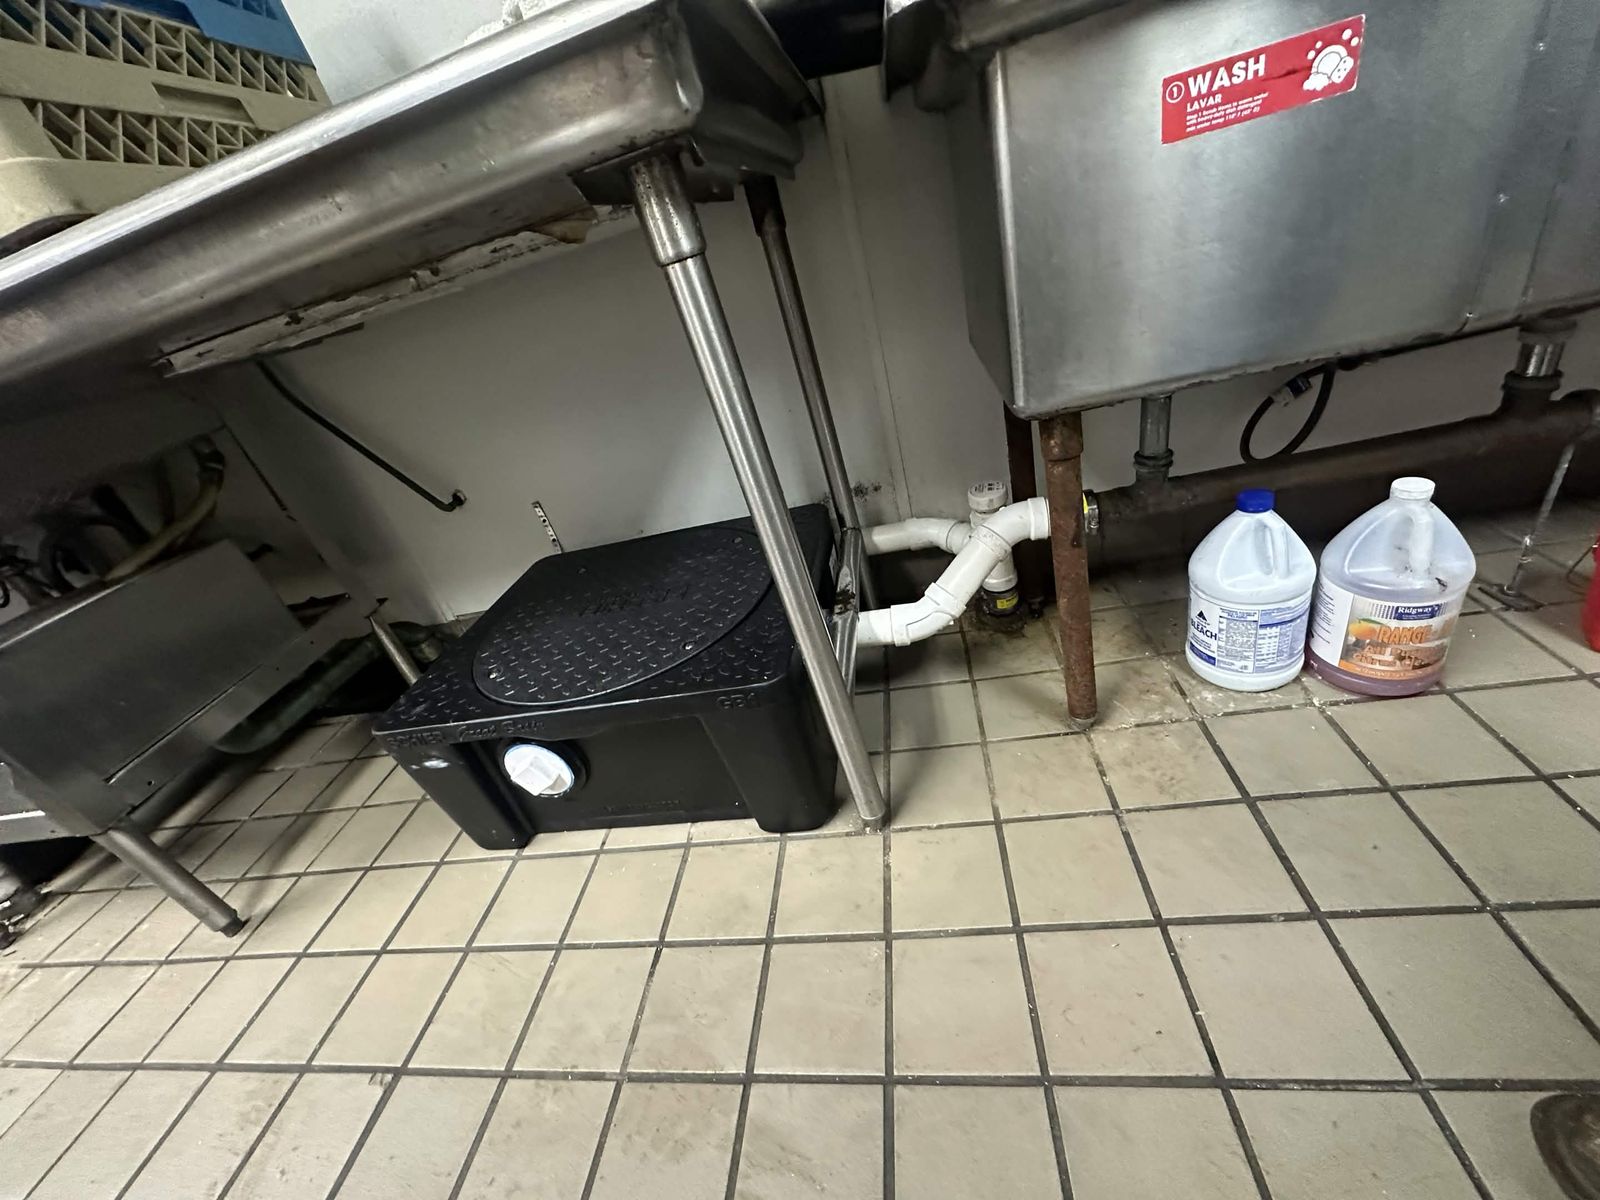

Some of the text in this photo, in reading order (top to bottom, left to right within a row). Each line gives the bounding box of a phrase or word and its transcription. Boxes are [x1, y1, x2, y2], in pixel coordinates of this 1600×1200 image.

[1187, 54, 1266, 97] WASH
[1186, 93, 1222, 112] LAVAR
[1397, 604, 1438, 615] Ridgway's
[1191, 618, 1218, 641] BLEACH
